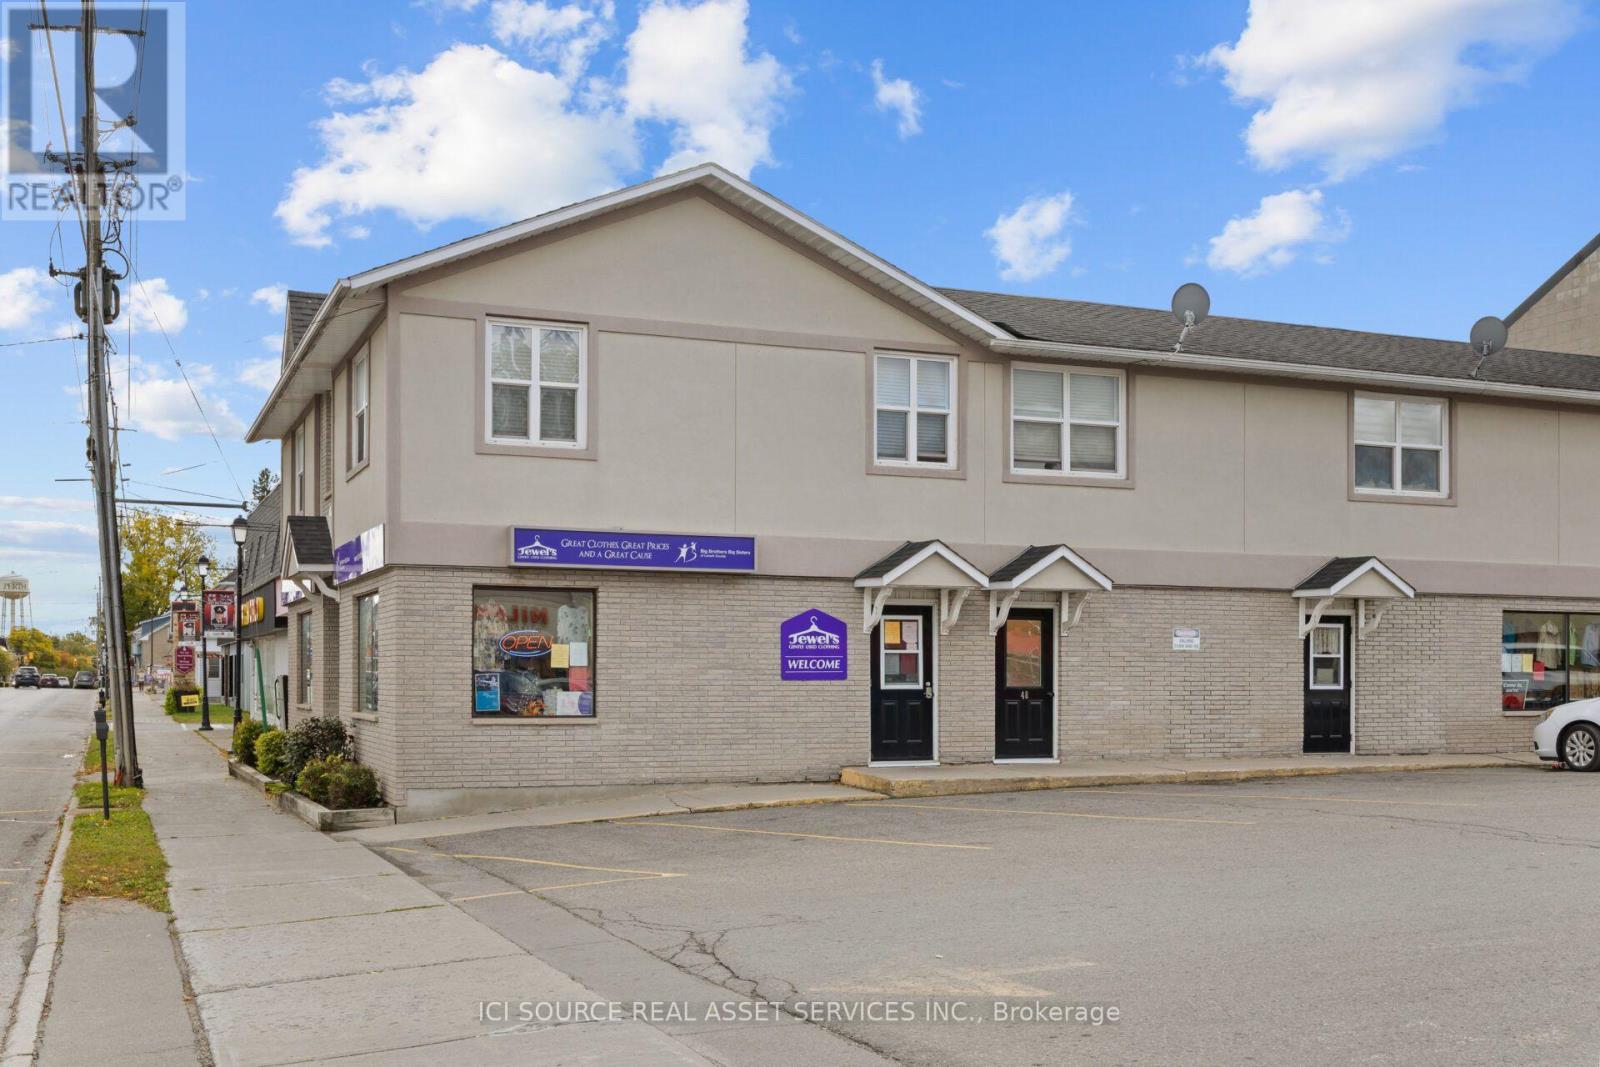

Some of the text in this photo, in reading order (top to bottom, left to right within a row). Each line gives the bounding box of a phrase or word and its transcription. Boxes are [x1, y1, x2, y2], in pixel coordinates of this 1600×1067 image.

[560, 538, 586, 548] GREAT
[621, 540, 646, 550] GREAT
[647, 541, 670, 550] PRICES
[579, 550, 596, 558] AND
[604, 550, 629, 559] GREAT
[630, 551, 653, 560] CAUSE
[501, 634, 553, 650] OPEN
[788, 632, 840, 645] Jewel's
[788, 659, 841, 669] WELCOME
